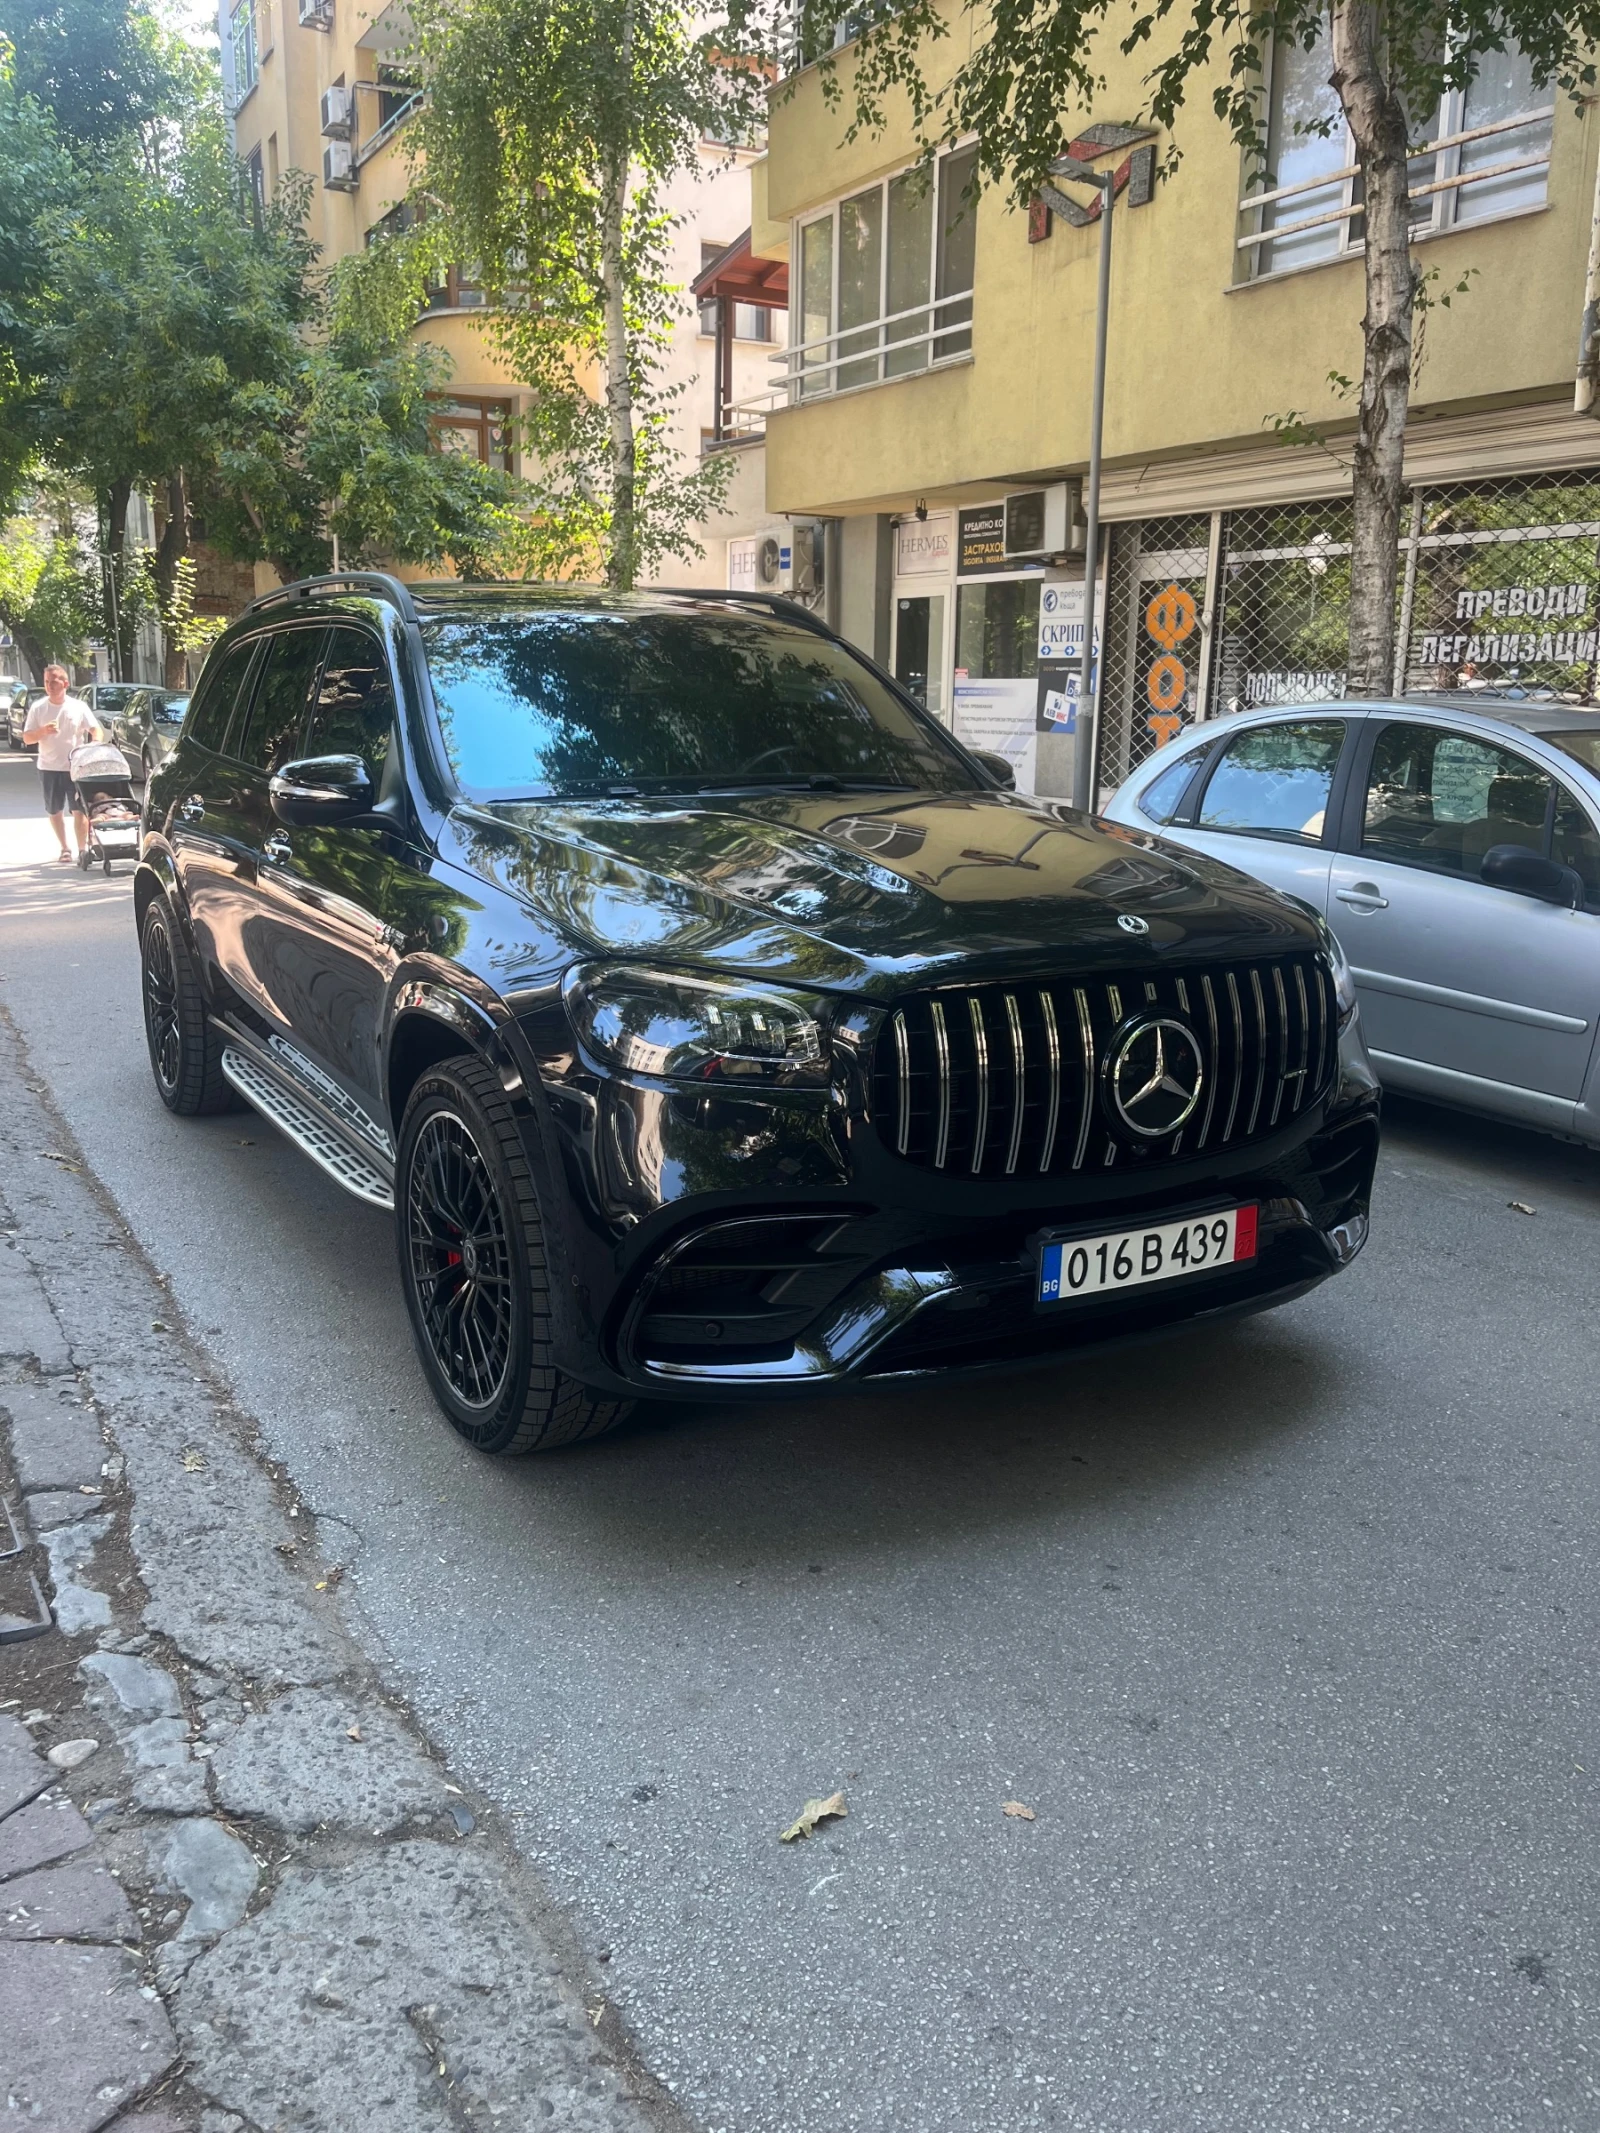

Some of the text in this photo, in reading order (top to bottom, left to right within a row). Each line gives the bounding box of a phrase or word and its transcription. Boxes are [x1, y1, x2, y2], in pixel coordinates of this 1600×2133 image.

[964, 520, 994, 532] КРЕДИТНО
[901, 534, 949, 554] HERMES
[1456, 584, 1587, 620] ПРЕВОДИ
[1042, 624, 1100, 643] СКРИПА
[1420, 631, 1600, 666] ЛЕГАЛИЗАЦИ
[1045, 708, 1056, 718] ЛЕВ
[1042, 1279, 1058, 1294] BG
